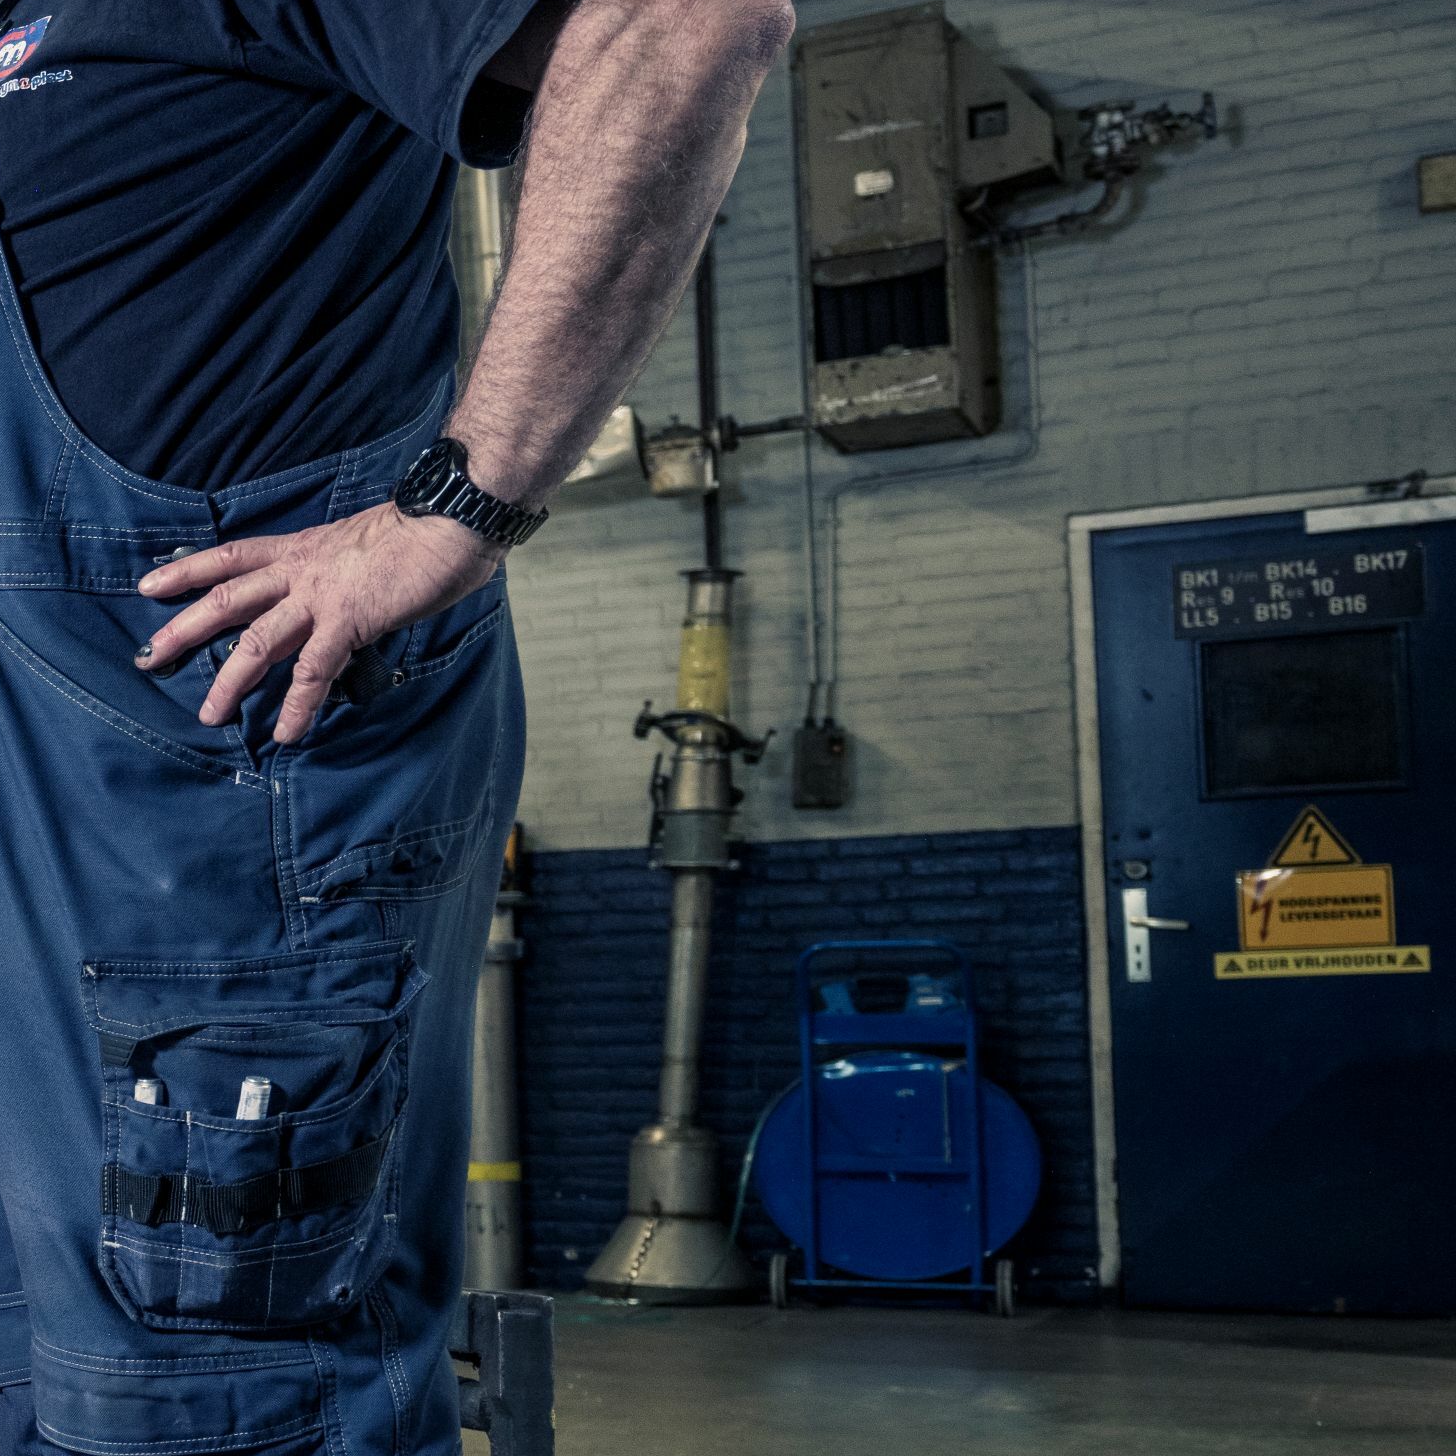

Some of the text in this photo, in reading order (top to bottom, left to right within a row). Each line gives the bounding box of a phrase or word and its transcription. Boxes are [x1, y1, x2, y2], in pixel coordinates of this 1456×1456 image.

[1180, 569, 1218, 590] BK1
[1264, 559, 1318, 582] BK14
[1353, 549, 1408, 574] BK17
[1220, 586, 1235, 606] 9
[1311, 576, 1335, 597] 10
[1181, 593, 1368, 629] LL5 B15 B16
[1279, 894, 1381, 908] HOOGSPANNING
[1280, 909, 1381, 923] LEVENSGEVAAR
[1247, 953, 1397, 971] DEUR VRIJHOUDEN
